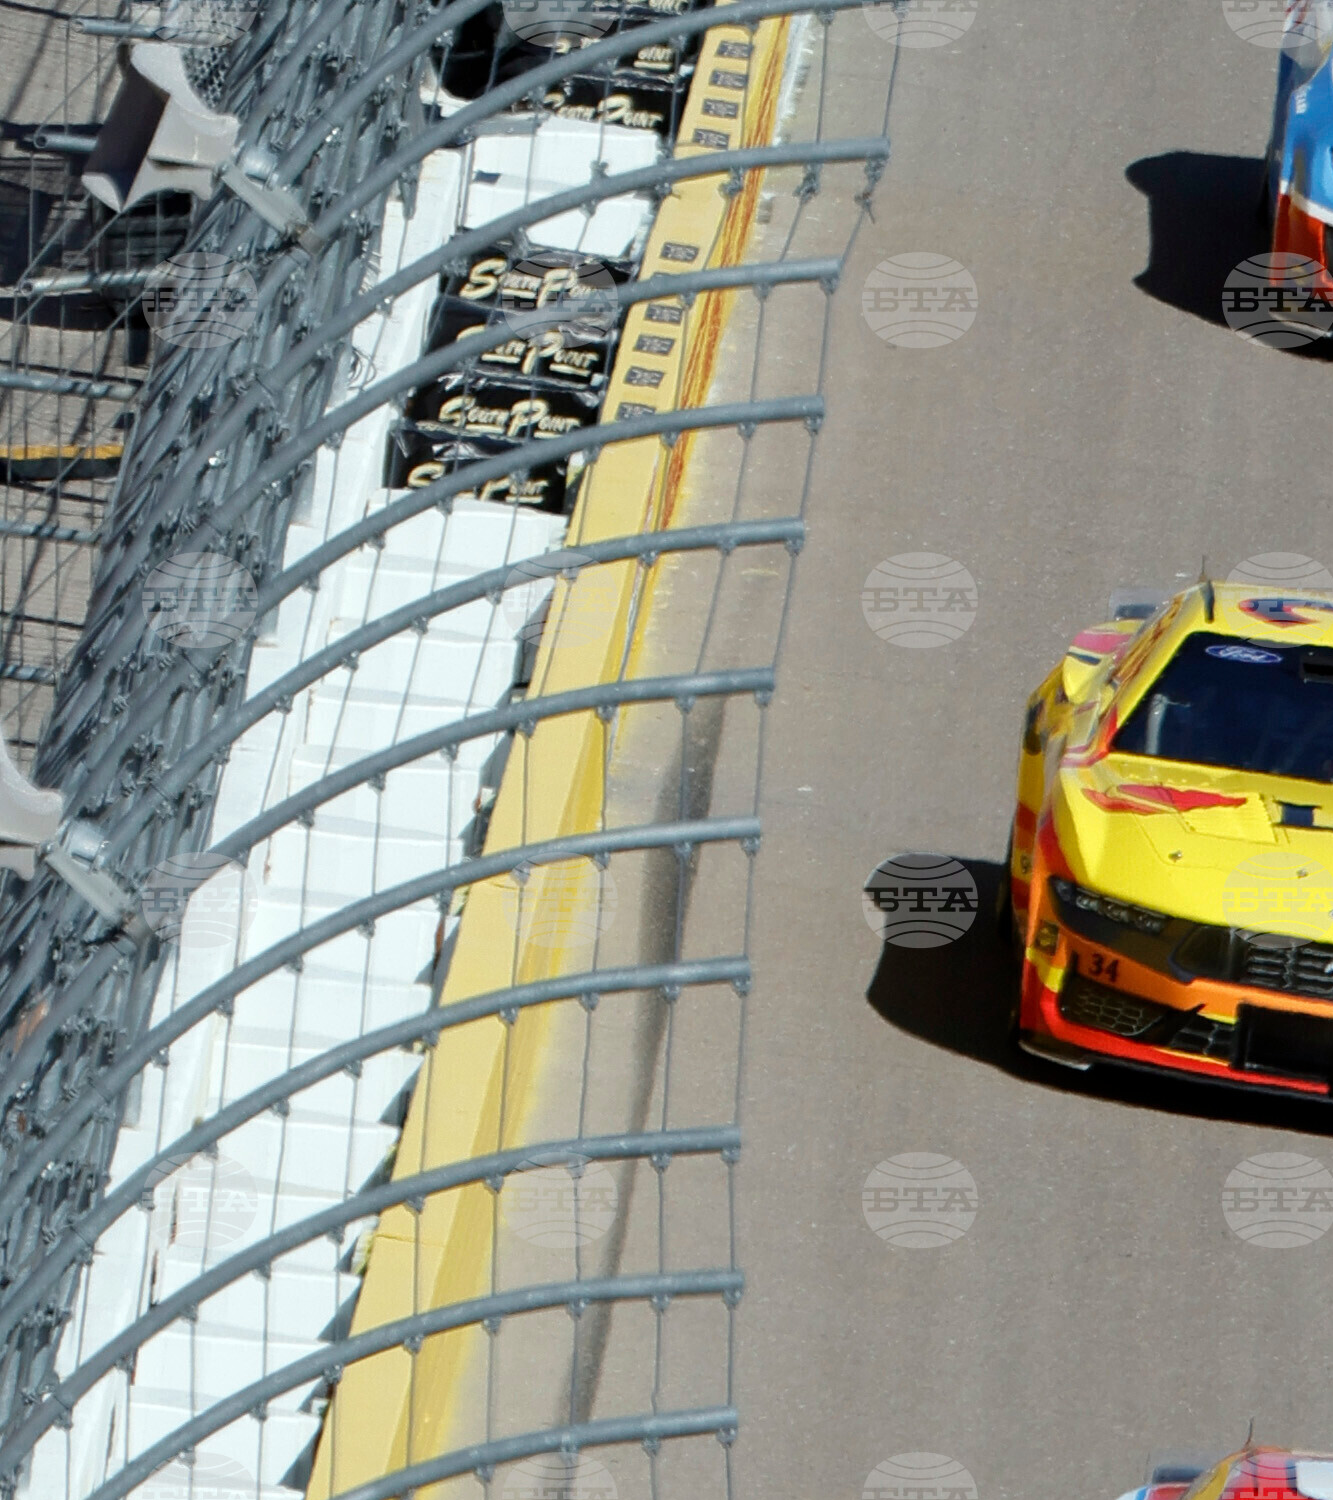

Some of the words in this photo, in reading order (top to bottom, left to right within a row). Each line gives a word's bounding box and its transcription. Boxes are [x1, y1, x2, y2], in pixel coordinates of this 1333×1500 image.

[438, 395, 511, 432] SOUTH
[507, 399, 581, 440] POINT
[1211, 644, 1274, 663] Ford
[1089, 953, 1119, 983] 34
